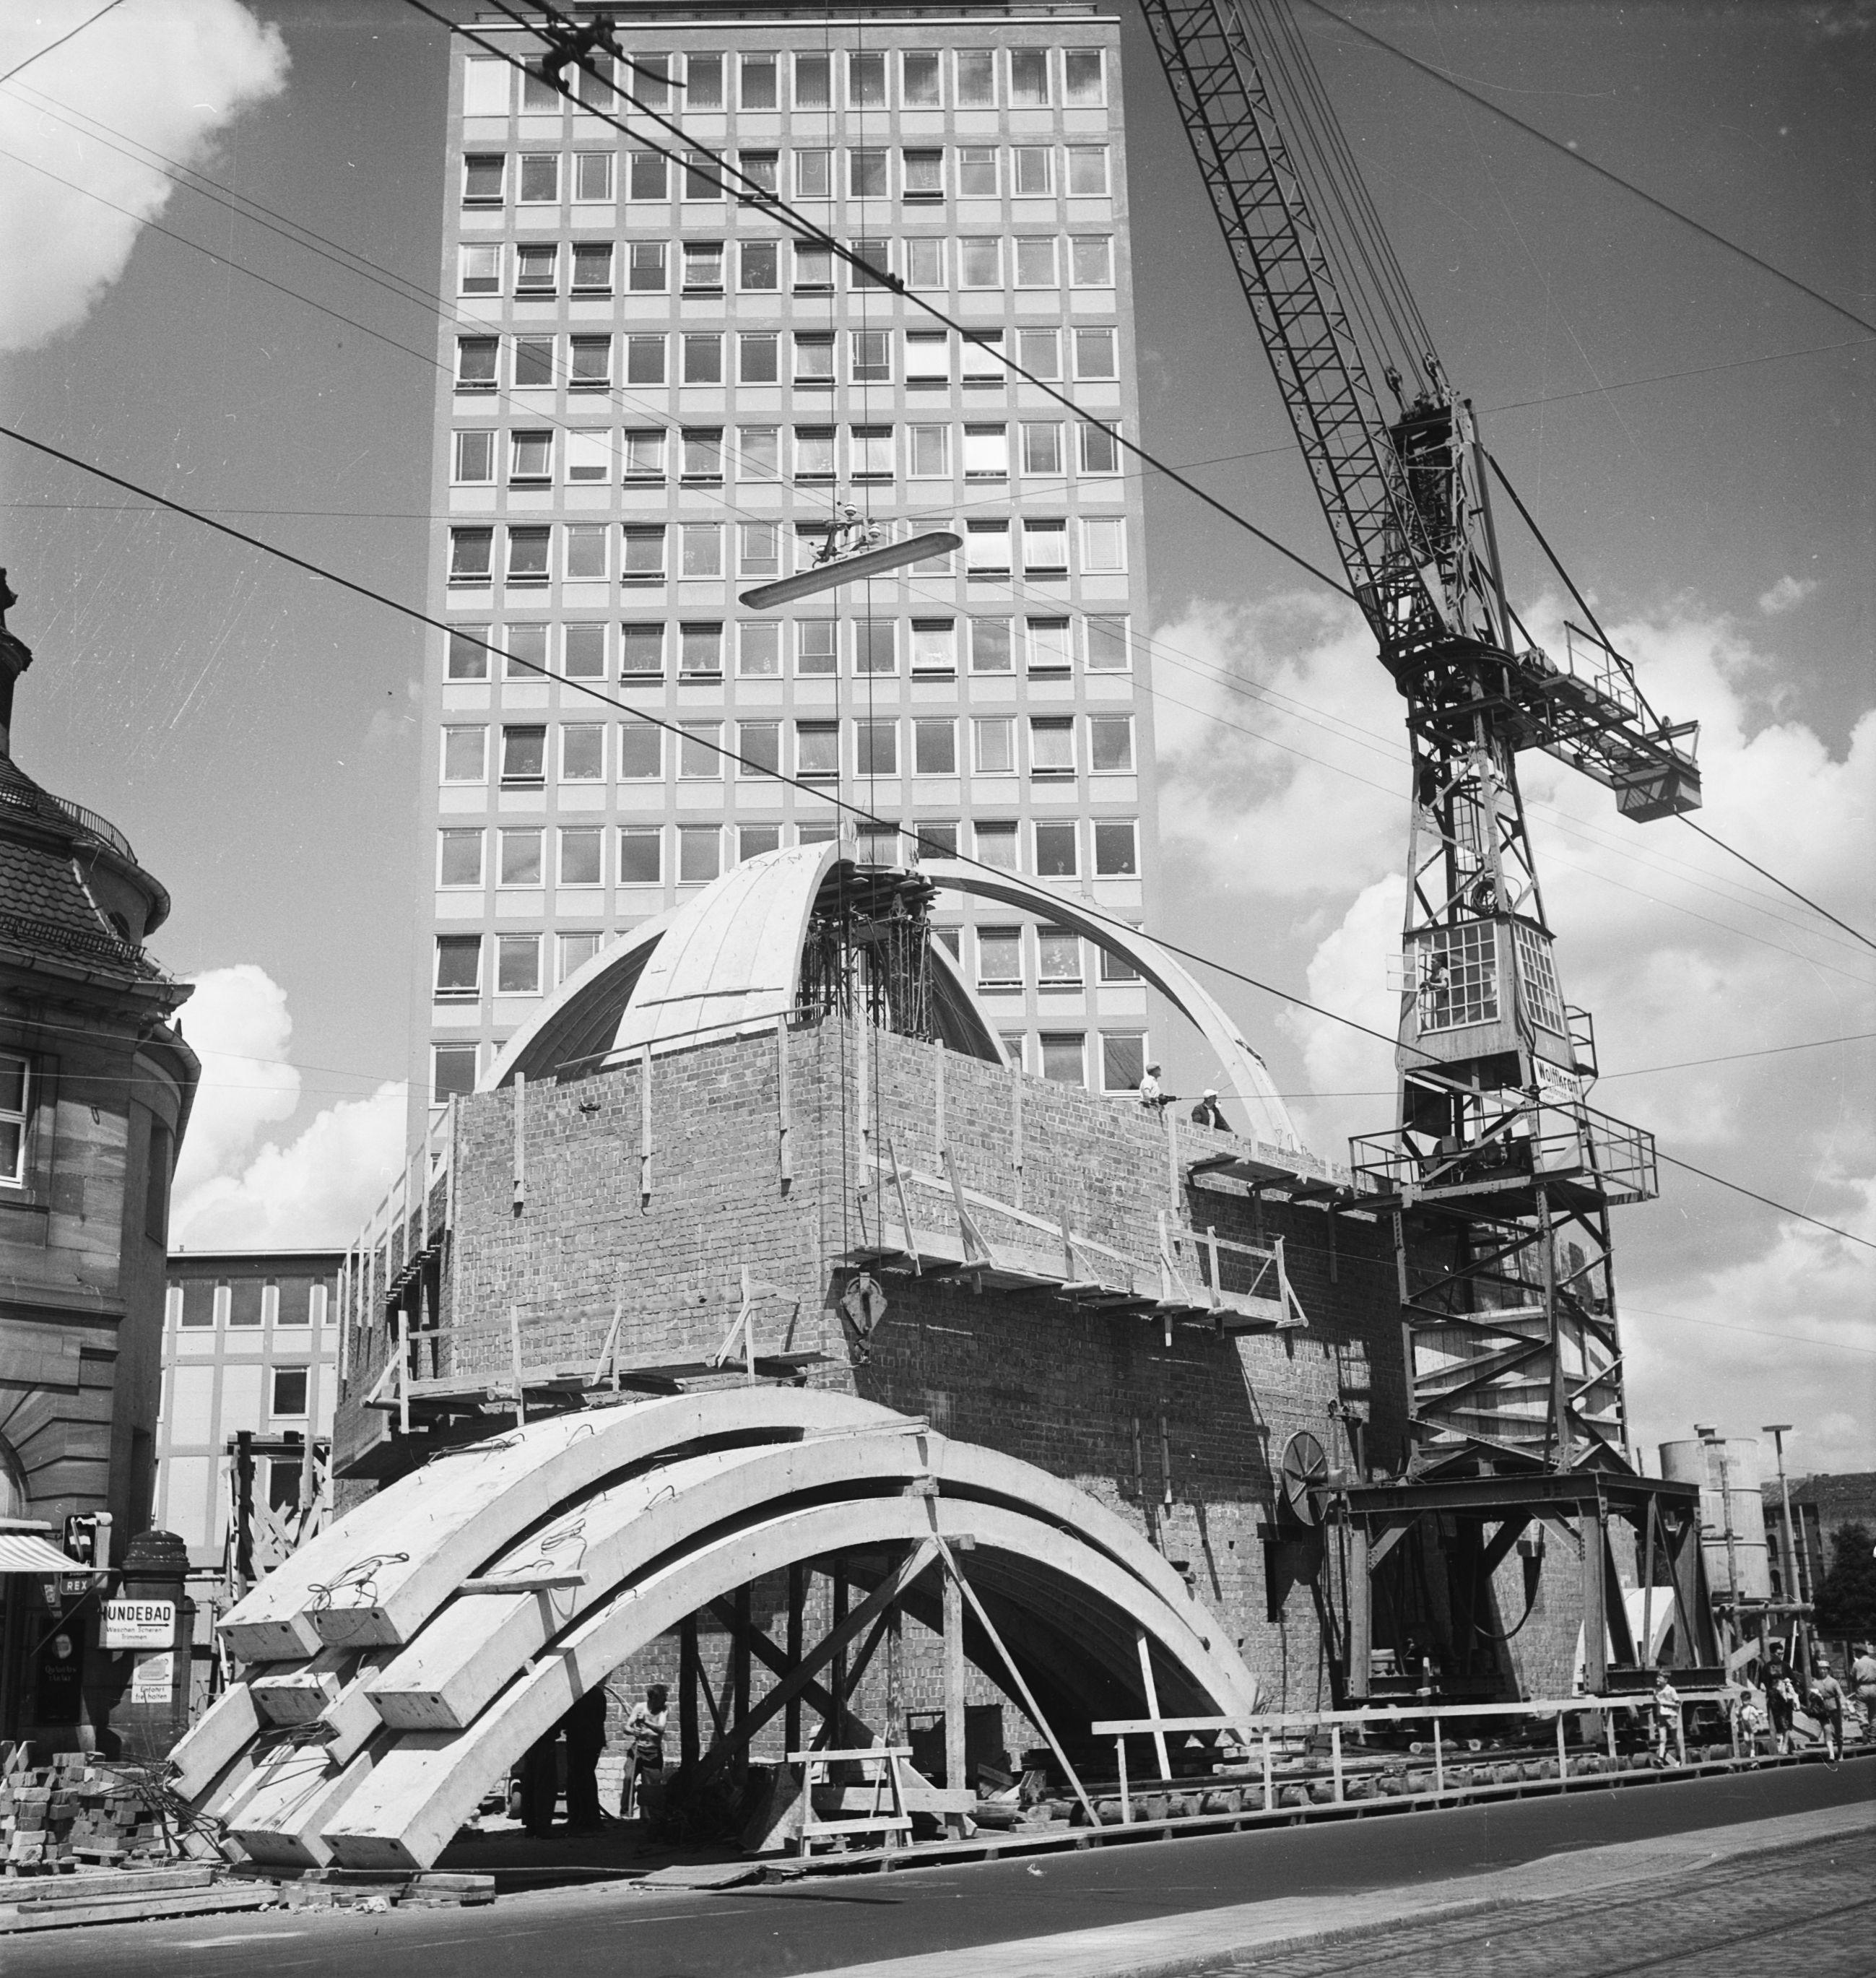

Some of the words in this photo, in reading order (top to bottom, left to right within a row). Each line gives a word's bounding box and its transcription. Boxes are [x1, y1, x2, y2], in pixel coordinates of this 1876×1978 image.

[1537, 1060, 1578, 1094] Wolffkran
[67, 1581, 87, 1591] REX
[99, 1606, 171, 1621] HUNDEBAD
